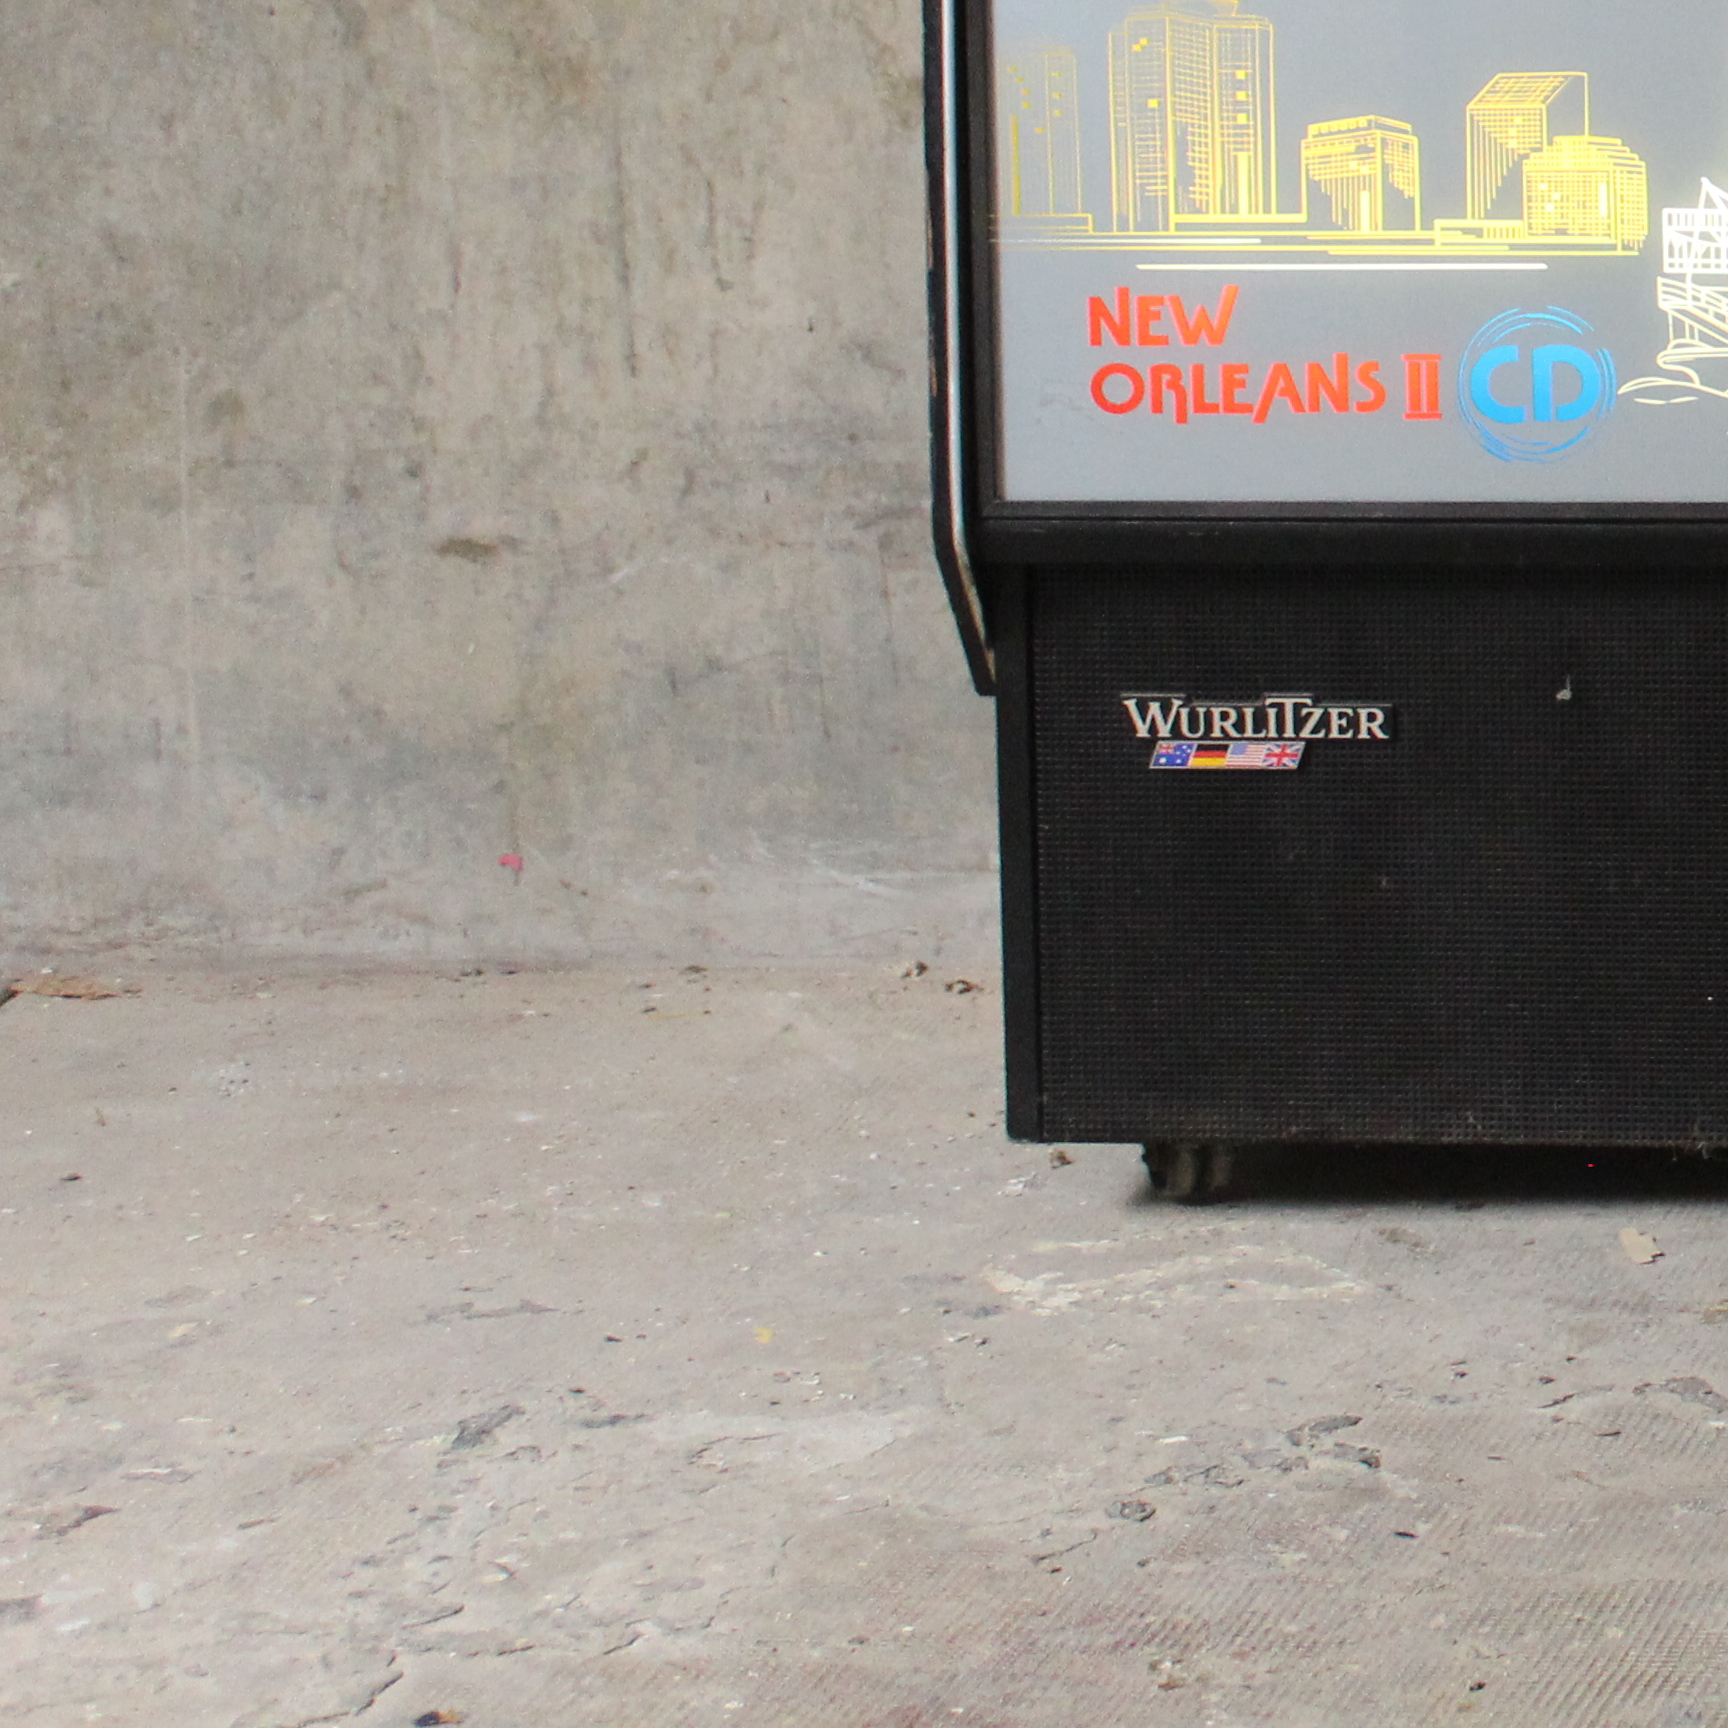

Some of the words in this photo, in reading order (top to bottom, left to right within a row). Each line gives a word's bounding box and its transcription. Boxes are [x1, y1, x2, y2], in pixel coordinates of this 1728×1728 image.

[1087, 285, 1239, 346] NEW
[1090, 353, 1387, 424] ORLEANS
[1402, 353, 1442, 420] II
[1470, 344, 1600, 424] CD
[1122, 697, 1390, 739] WURLITZER
